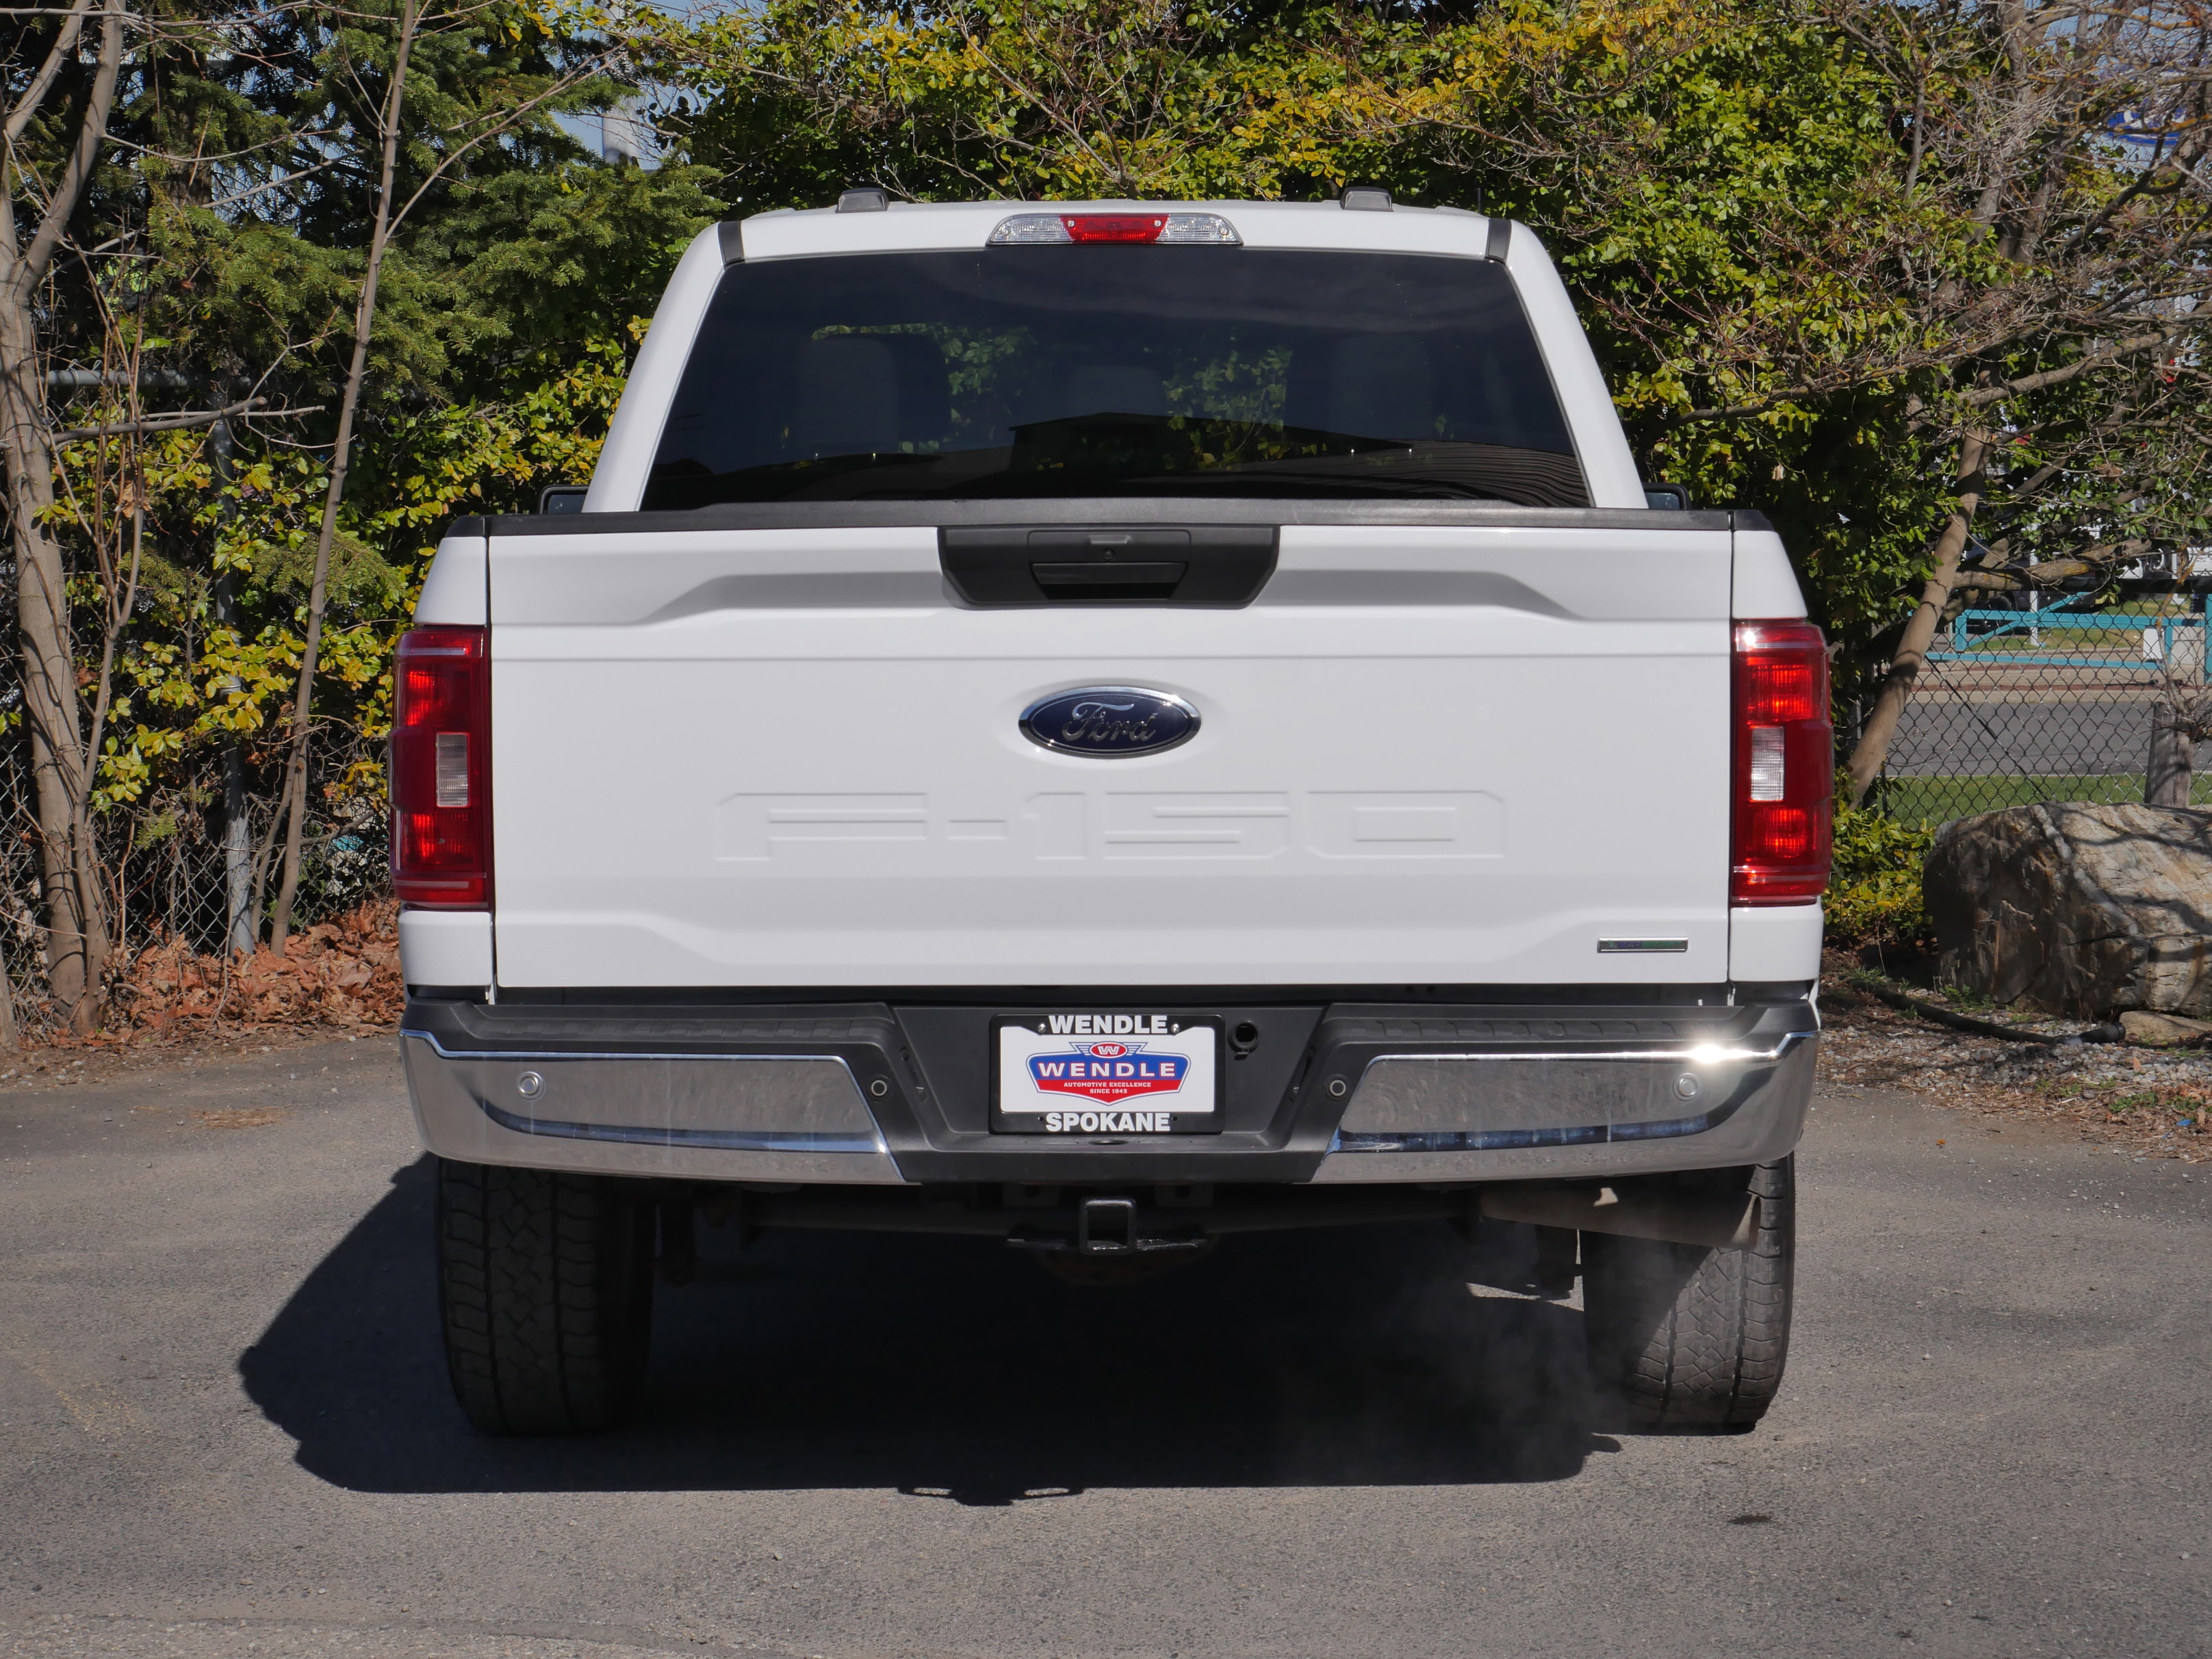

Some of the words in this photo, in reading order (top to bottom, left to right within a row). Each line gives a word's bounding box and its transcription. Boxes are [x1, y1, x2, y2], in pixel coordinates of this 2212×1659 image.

[1062, 702, 1158, 742] Ford
[712, 790, 1507, 862] F-150
[1049, 1015, 1168, 1034] WENDLE
[1097, 1046, 1120, 1055] W
[1038, 1062, 1176, 1077] WENDLE
[1046, 1112, 1171, 1132] SPOKANE
